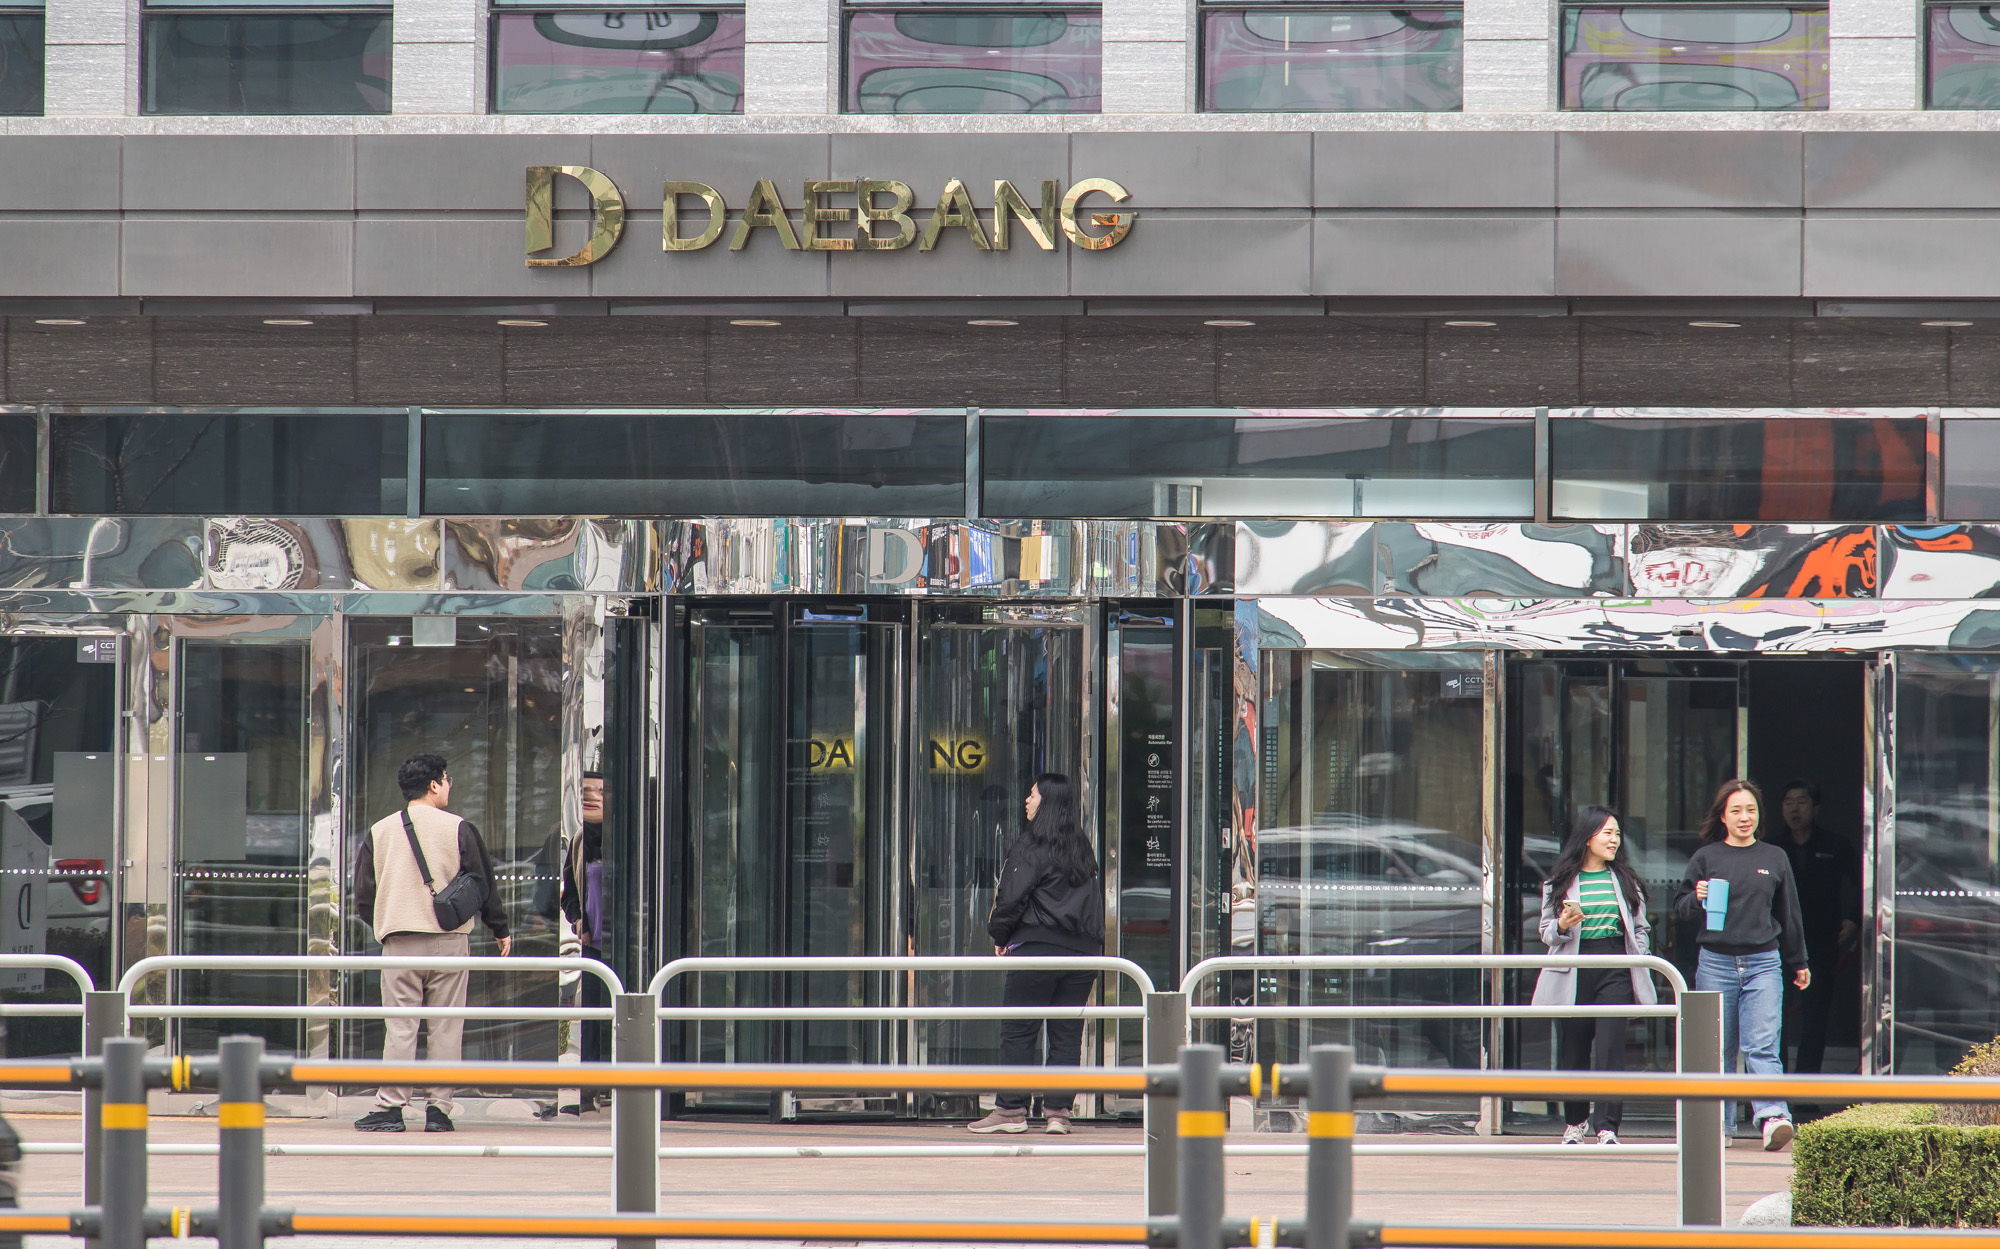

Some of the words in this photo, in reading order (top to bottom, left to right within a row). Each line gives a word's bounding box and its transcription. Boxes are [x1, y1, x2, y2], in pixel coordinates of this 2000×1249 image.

[525, 165, 625, 268] D
[662, 177, 1136, 253] DAEBANG
[869, 528, 924, 584] D
